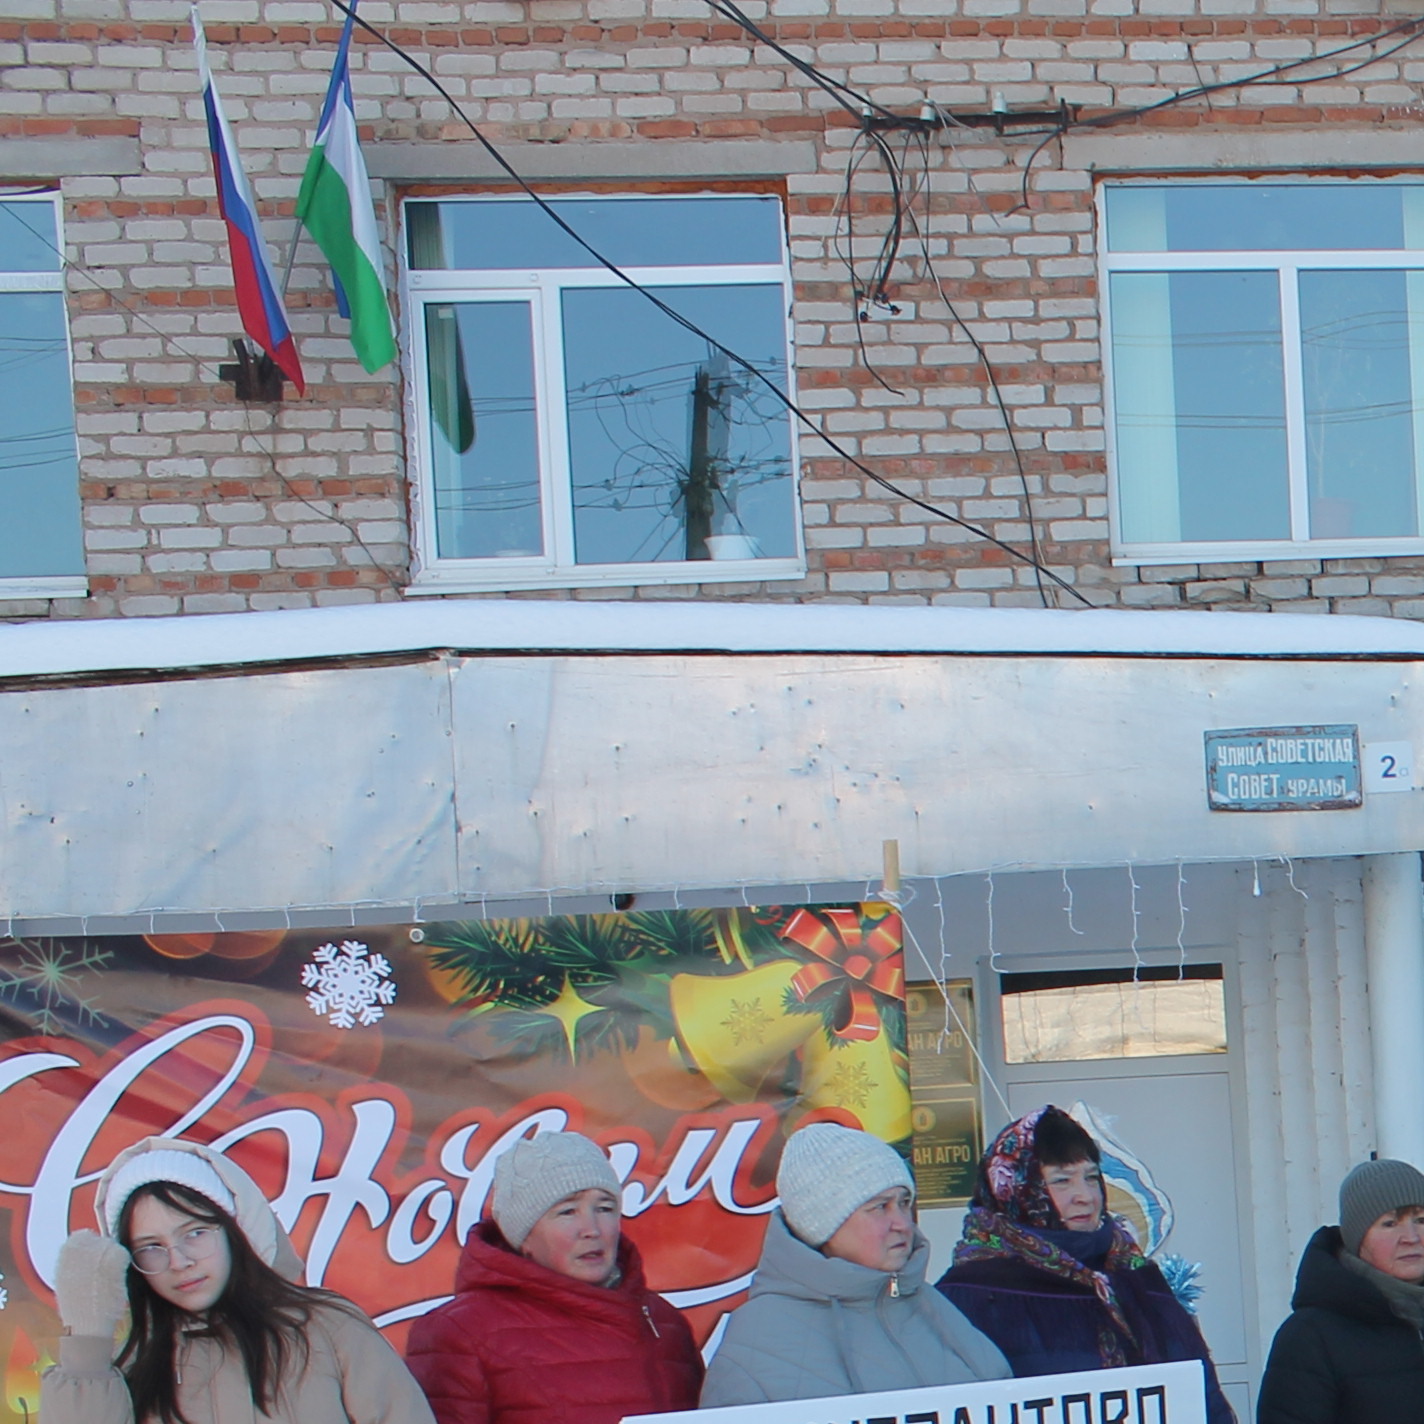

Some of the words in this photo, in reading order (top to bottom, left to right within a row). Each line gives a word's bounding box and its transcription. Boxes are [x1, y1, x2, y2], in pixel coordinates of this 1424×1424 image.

[1266, 737, 1354, 764] СОВЕТСКАЯ
[1227, 772, 1281, 799] СОВЕТ
[1287, 776, 1347, 798] УРАМЫ
[935, 1144, 971, 1164] АГРО
